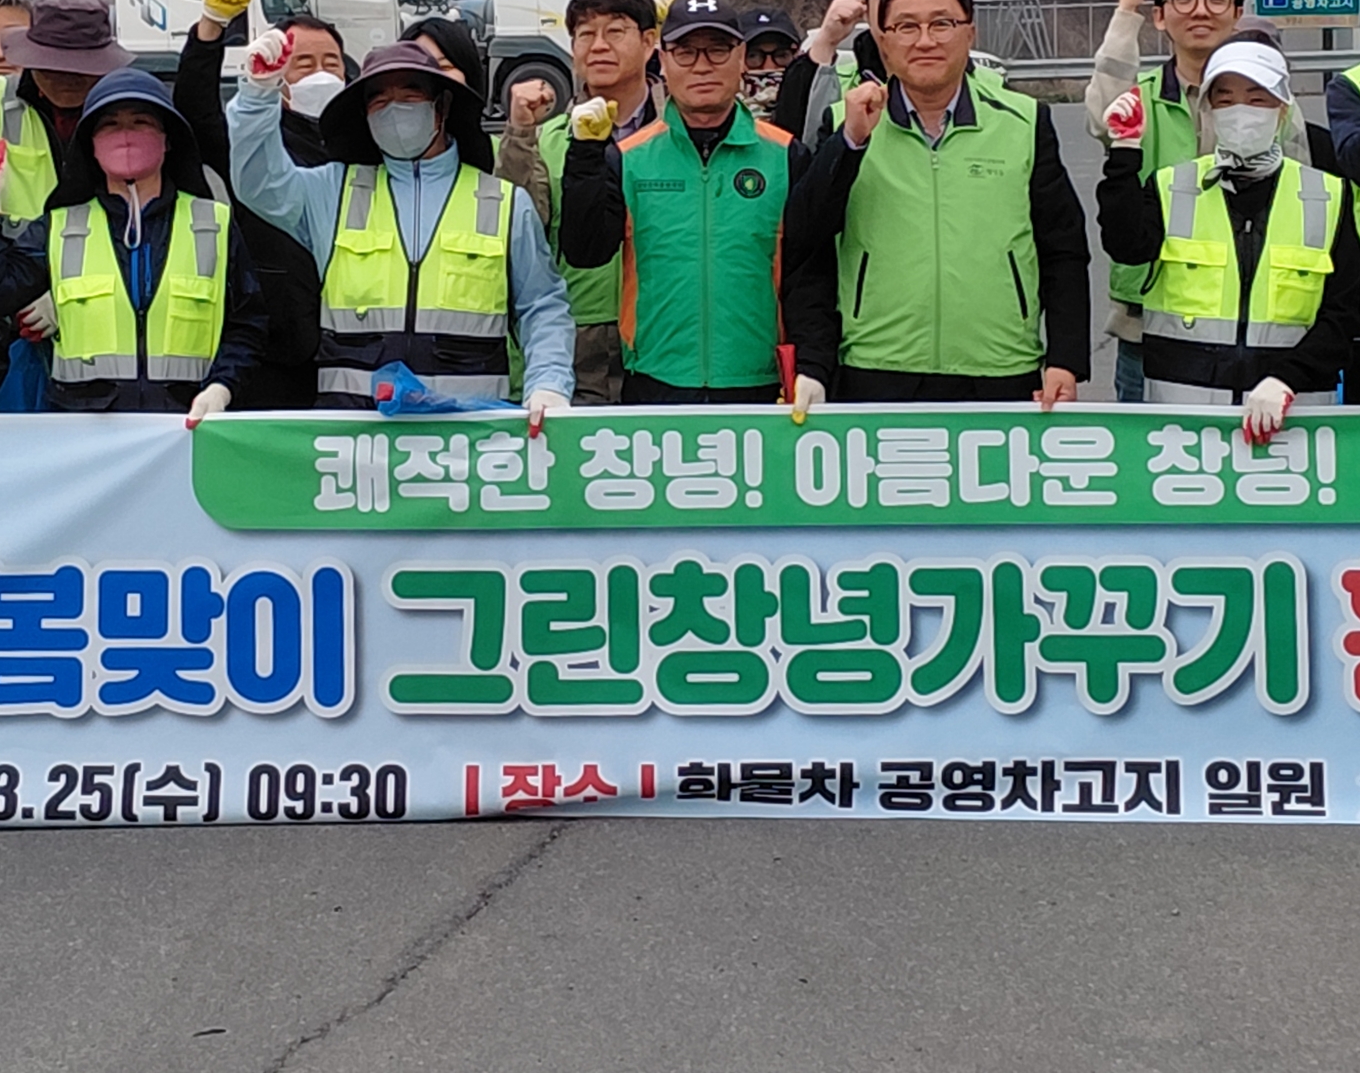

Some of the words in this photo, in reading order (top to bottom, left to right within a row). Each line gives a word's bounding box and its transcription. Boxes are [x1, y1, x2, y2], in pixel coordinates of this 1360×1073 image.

[313, 431, 556, 513] 쾌적한
[579, 428, 764, 511] 창녕!
[794, 426, 1119, 508] 아름다운
[1146, 424, 1337, 506] 창녕!
[385, 558, 1300, 708] 그린창녕가꾸기
[246, 763, 408, 820] 09:30
[878, 759, 1181, 815] 공영차고지
[1205, 760, 1327, 817] 일원
